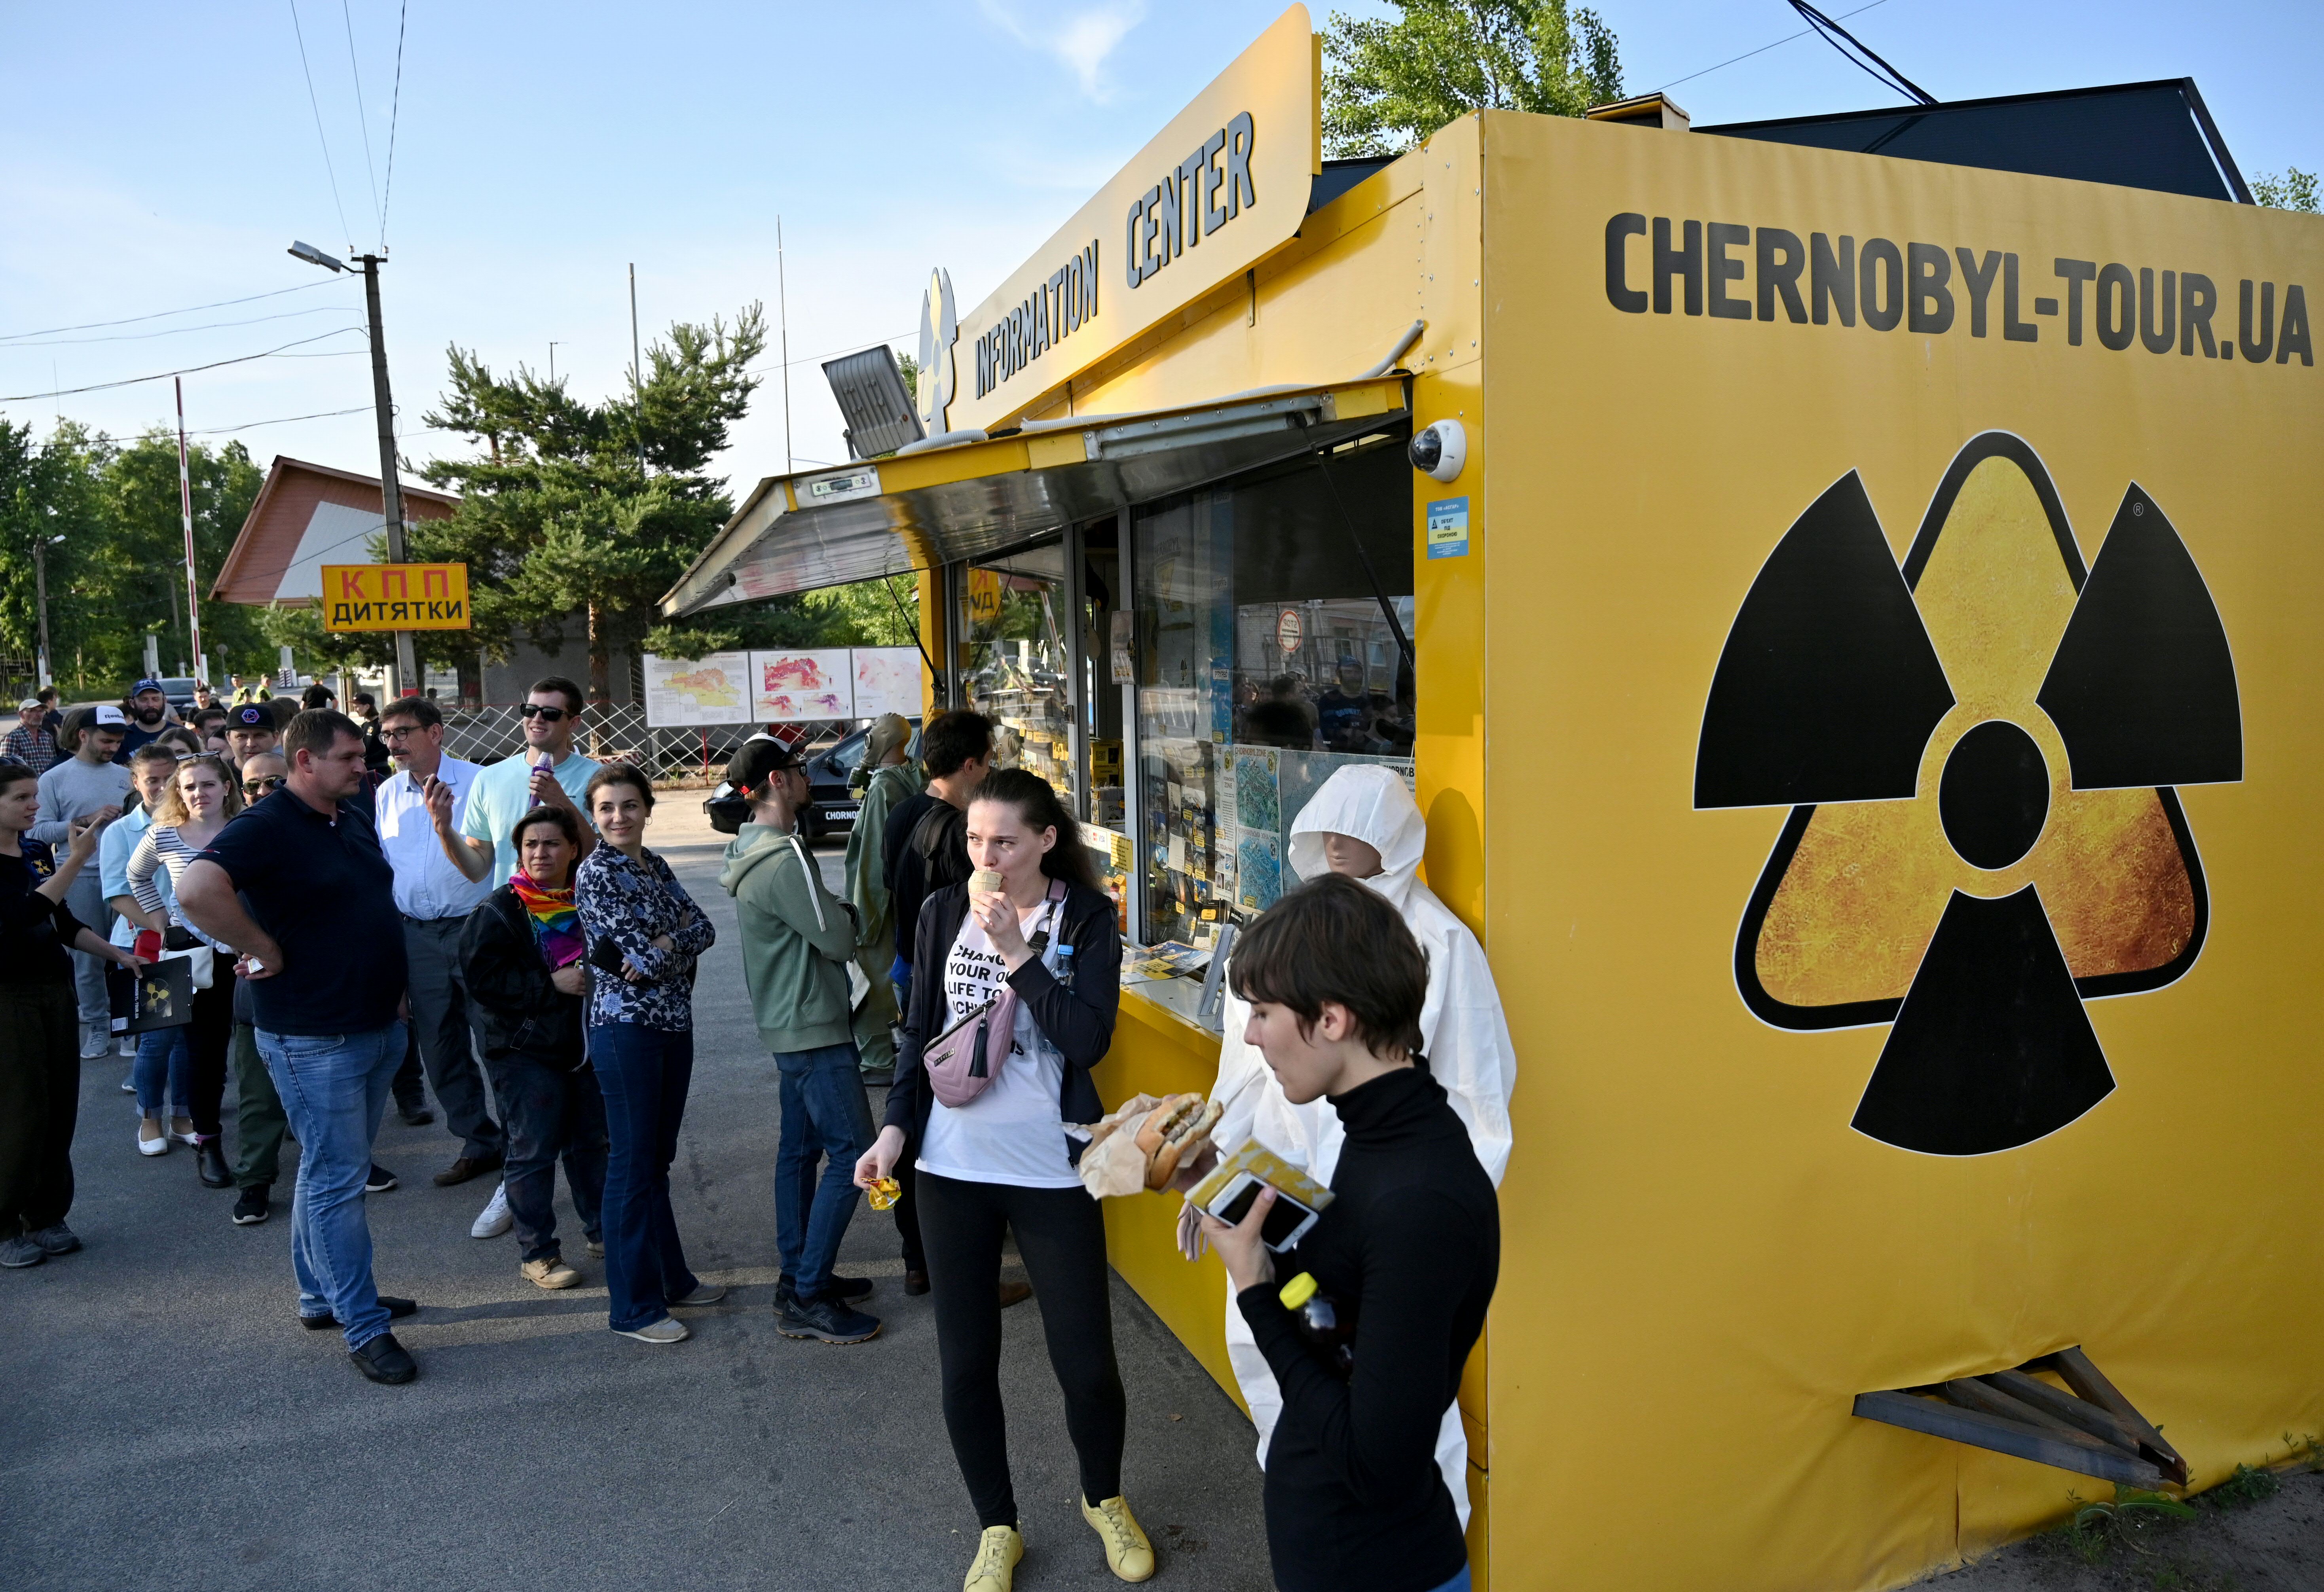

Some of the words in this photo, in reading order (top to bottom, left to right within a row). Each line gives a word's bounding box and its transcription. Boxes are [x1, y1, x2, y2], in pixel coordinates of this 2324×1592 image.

[975, 239, 1099, 400] INFORMATION
[1127, 111, 1255, 289] CENTER
[1605, 212, 2314, 366] CHERNOBYL-TOUR.UA
[333, 600, 463, 625] ДИТЯТКИ
[1235, 747, 1256, 756] CHORNOBYL
[1256, 749, 1266, 757] ZONE
[825, 810, 859, 820] CHORNO
[950, 962, 990, 981] YOUR
[949, 981, 976, 997] LIFE
